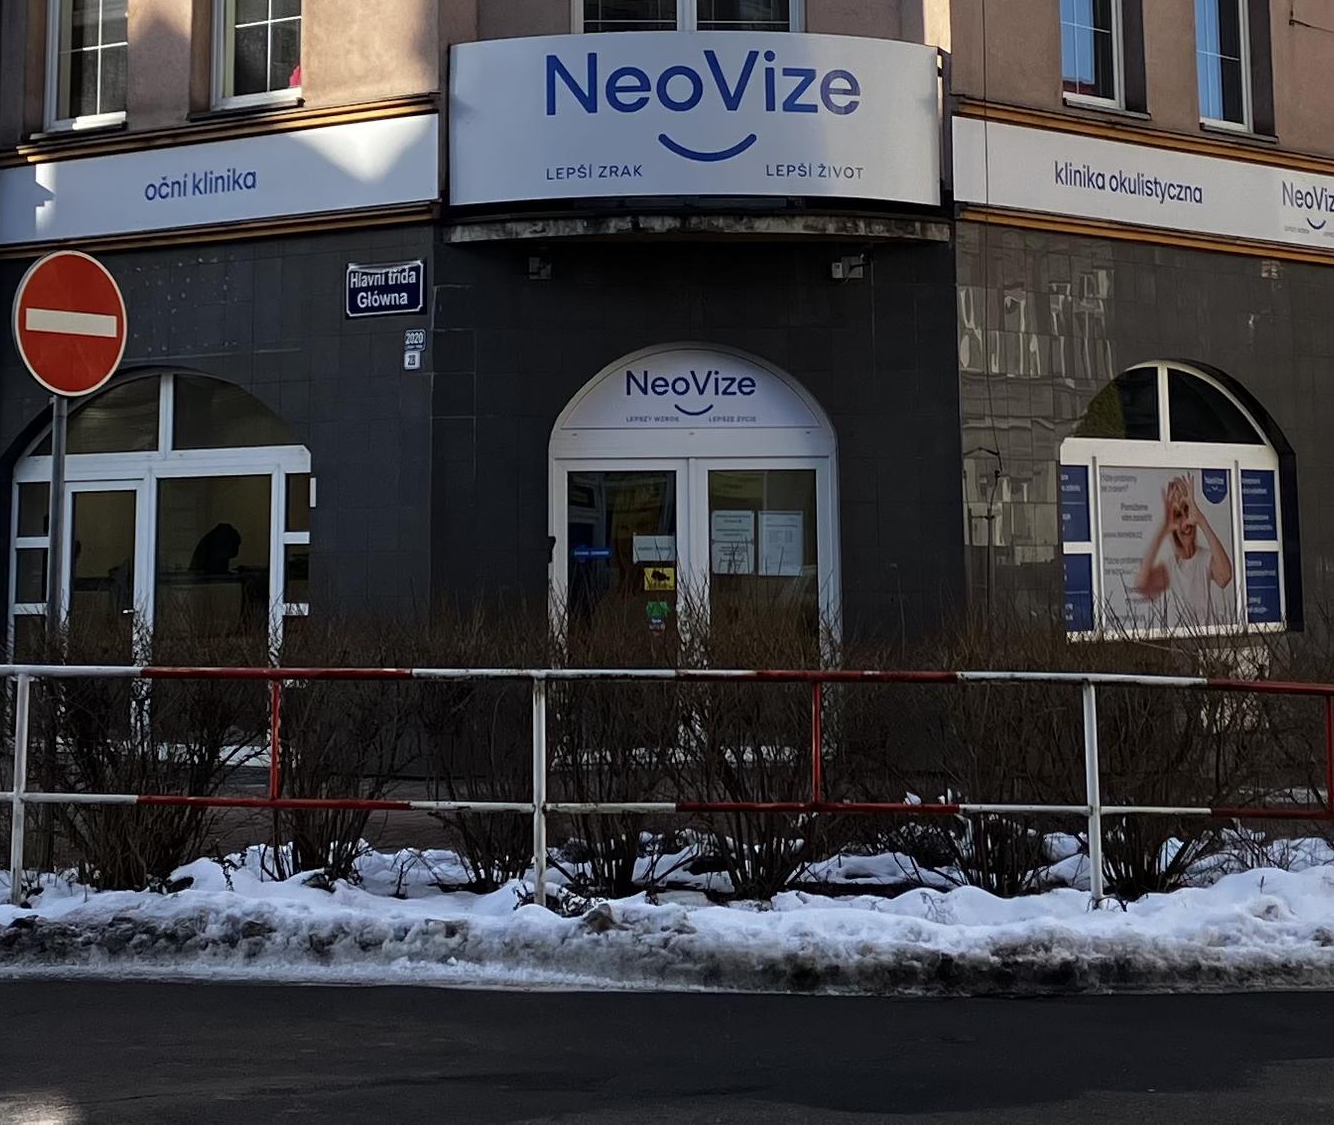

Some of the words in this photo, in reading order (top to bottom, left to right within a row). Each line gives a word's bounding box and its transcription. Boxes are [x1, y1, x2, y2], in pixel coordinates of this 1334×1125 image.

[545, 48, 862, 116] NeoVize
[192, 168, 257, 196] klinika
[545, 163, 593, 181] LEPŠÍ
[598, 164, 643, 179] ZRAK
[766, 162, 813, 179] LEPŠÍ
[818, 163, 865, 180] ŽIVOT
[1054, 161, 1106, 191] klinika
[1109, 169, 1203, 205] okulistyczna
[357, 290, 408, 309] Główna
[405, 332, 424, 346] 2020
[626, 370, 756, 396] NeoVize
